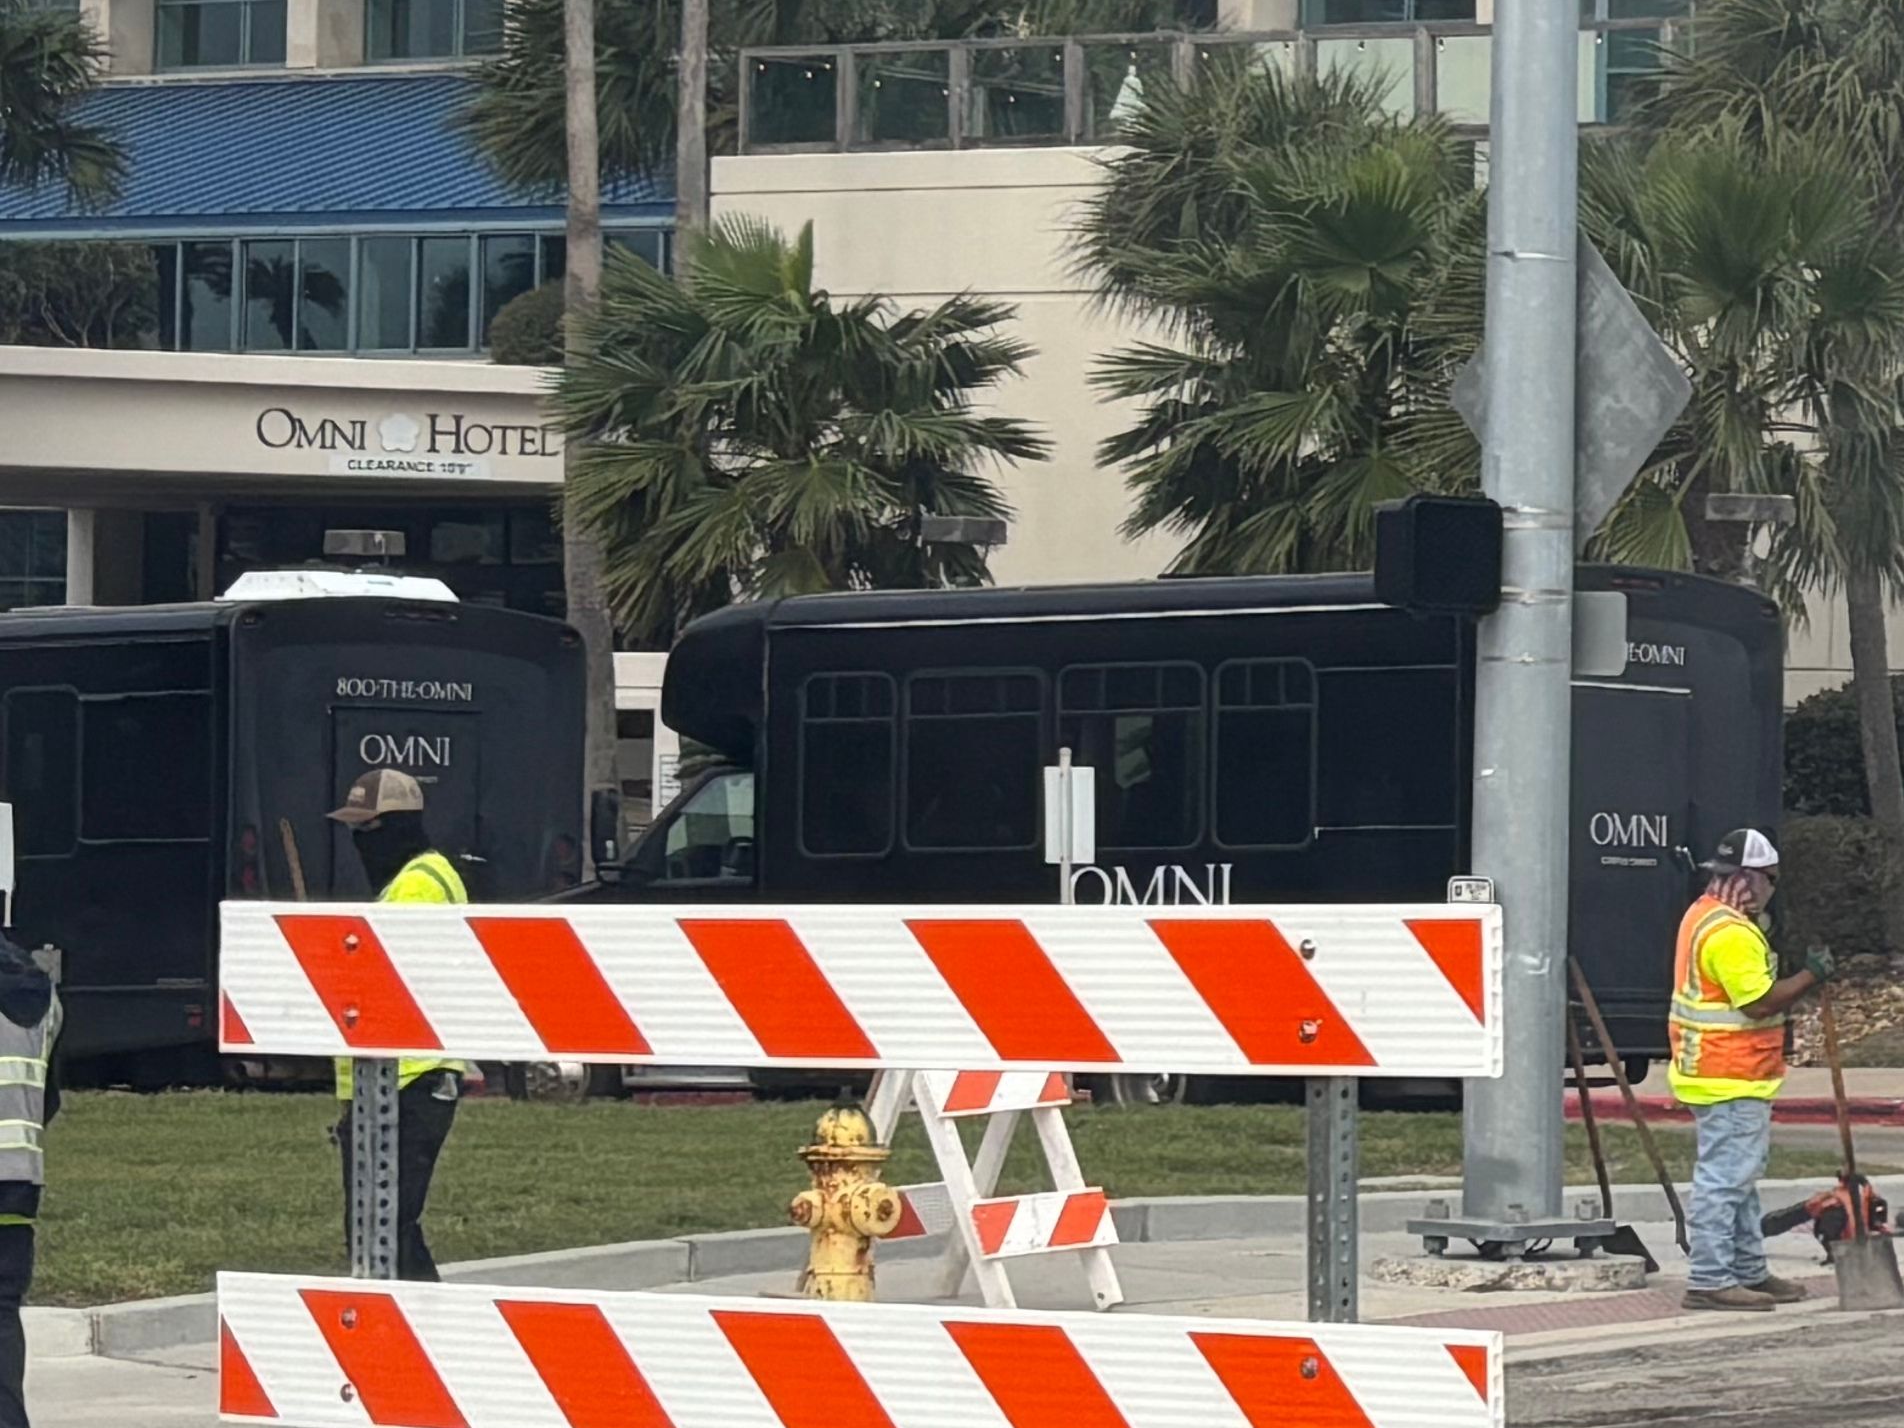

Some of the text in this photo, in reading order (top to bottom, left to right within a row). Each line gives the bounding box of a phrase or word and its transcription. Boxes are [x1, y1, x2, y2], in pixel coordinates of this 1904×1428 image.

[347, 459, 434, 473] CLEARANCE
[360, 734, 450, 766] OMNI
[1590, 812, 1668, 847] OMNI
[1069, 864, 1233, 905] OMNI
